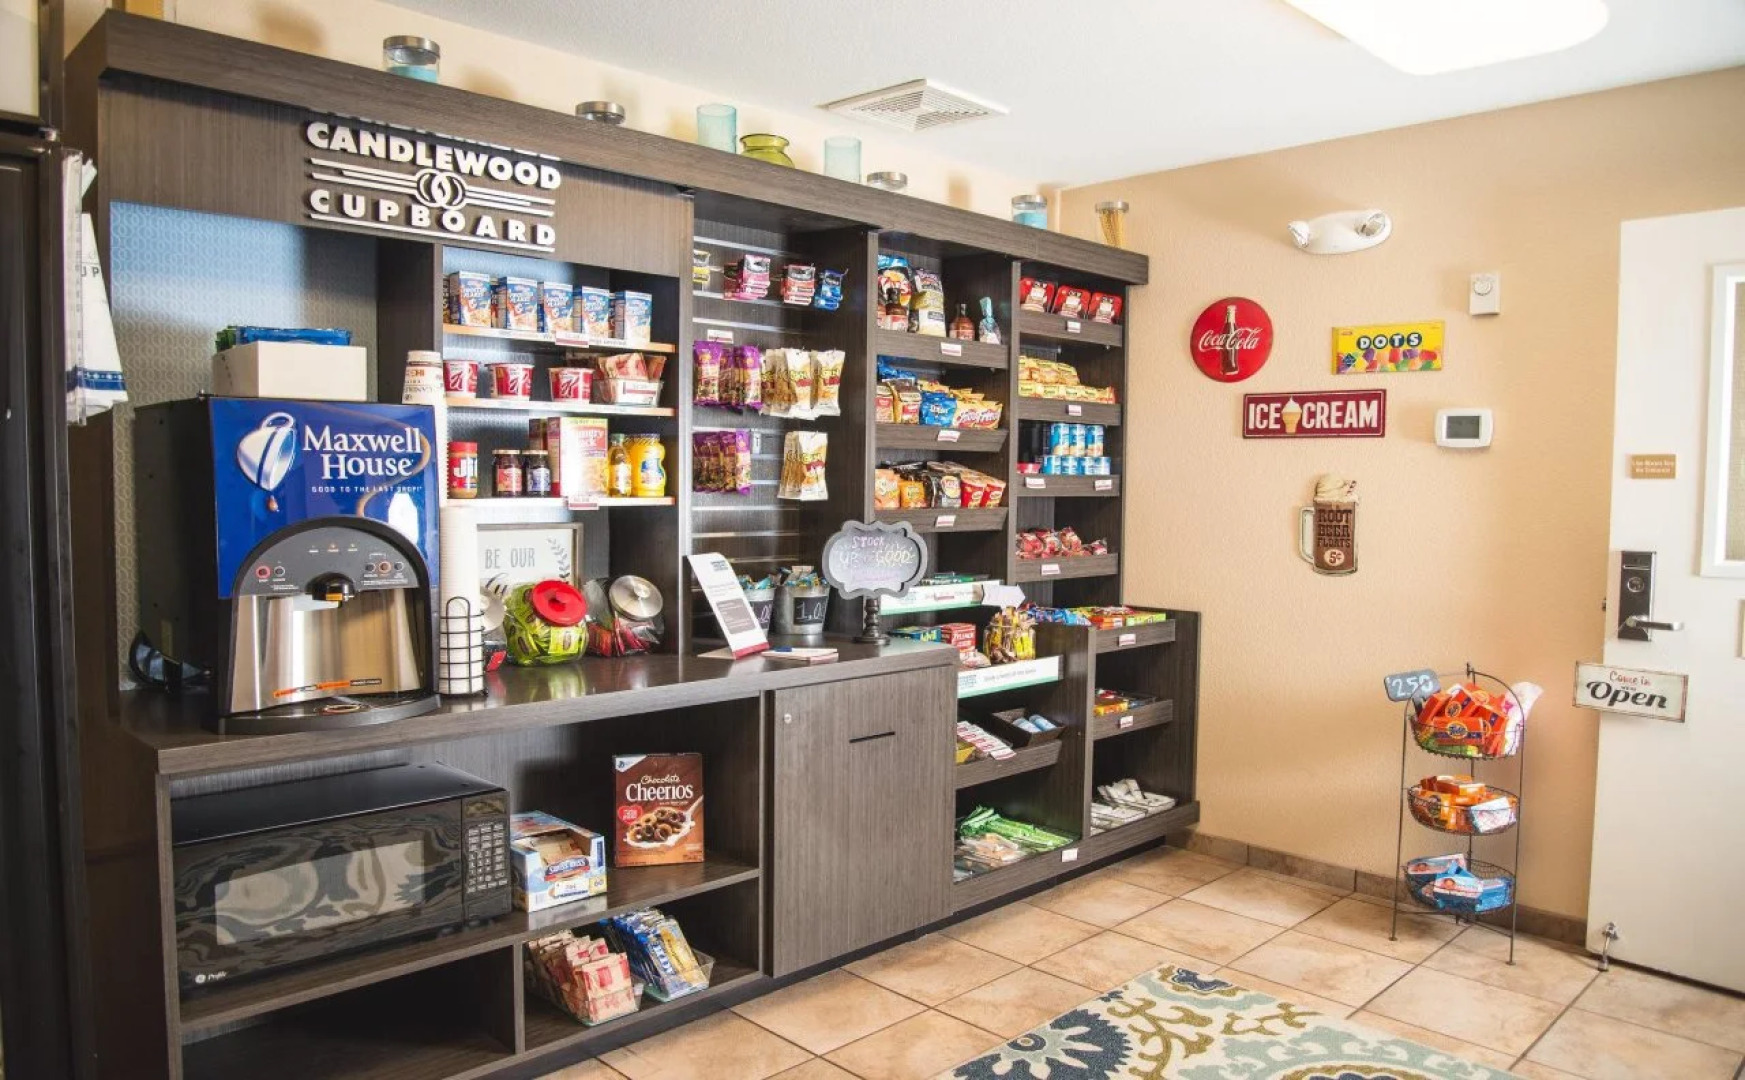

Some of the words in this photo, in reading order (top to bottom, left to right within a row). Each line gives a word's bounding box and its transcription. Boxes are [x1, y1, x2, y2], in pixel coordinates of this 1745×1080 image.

[306, 121, 562, 190] CANDLEWOOD
[309, 188, 556, 246] CUPBOARD
[1359, 333, 1420, 349] DOTS
[1248, 403, 1281, 430] ICE
[1302, 400, 1379, 429] CREAM
[303, 424, 423, 454] Maxwell
[321, 453, 413, 480] House
[1317, 509, 1352, 523] ROOT
[1317, 525, 1351, 538] BEER
[851, 535, 885, 549] STOCK
[1317, 538, 1352, 548] FLOATS
[485, 548, 501, 569] BE
[510, 547, 536, 568] OUR
[1609, 670, 1638, 684] Come
[1640, 676, 1651, 686] in
[1586, 681, 1667, 709] Open
[640, 772, 681, 785] Chocolate
[625, 782, 694, 802] Cheerios
